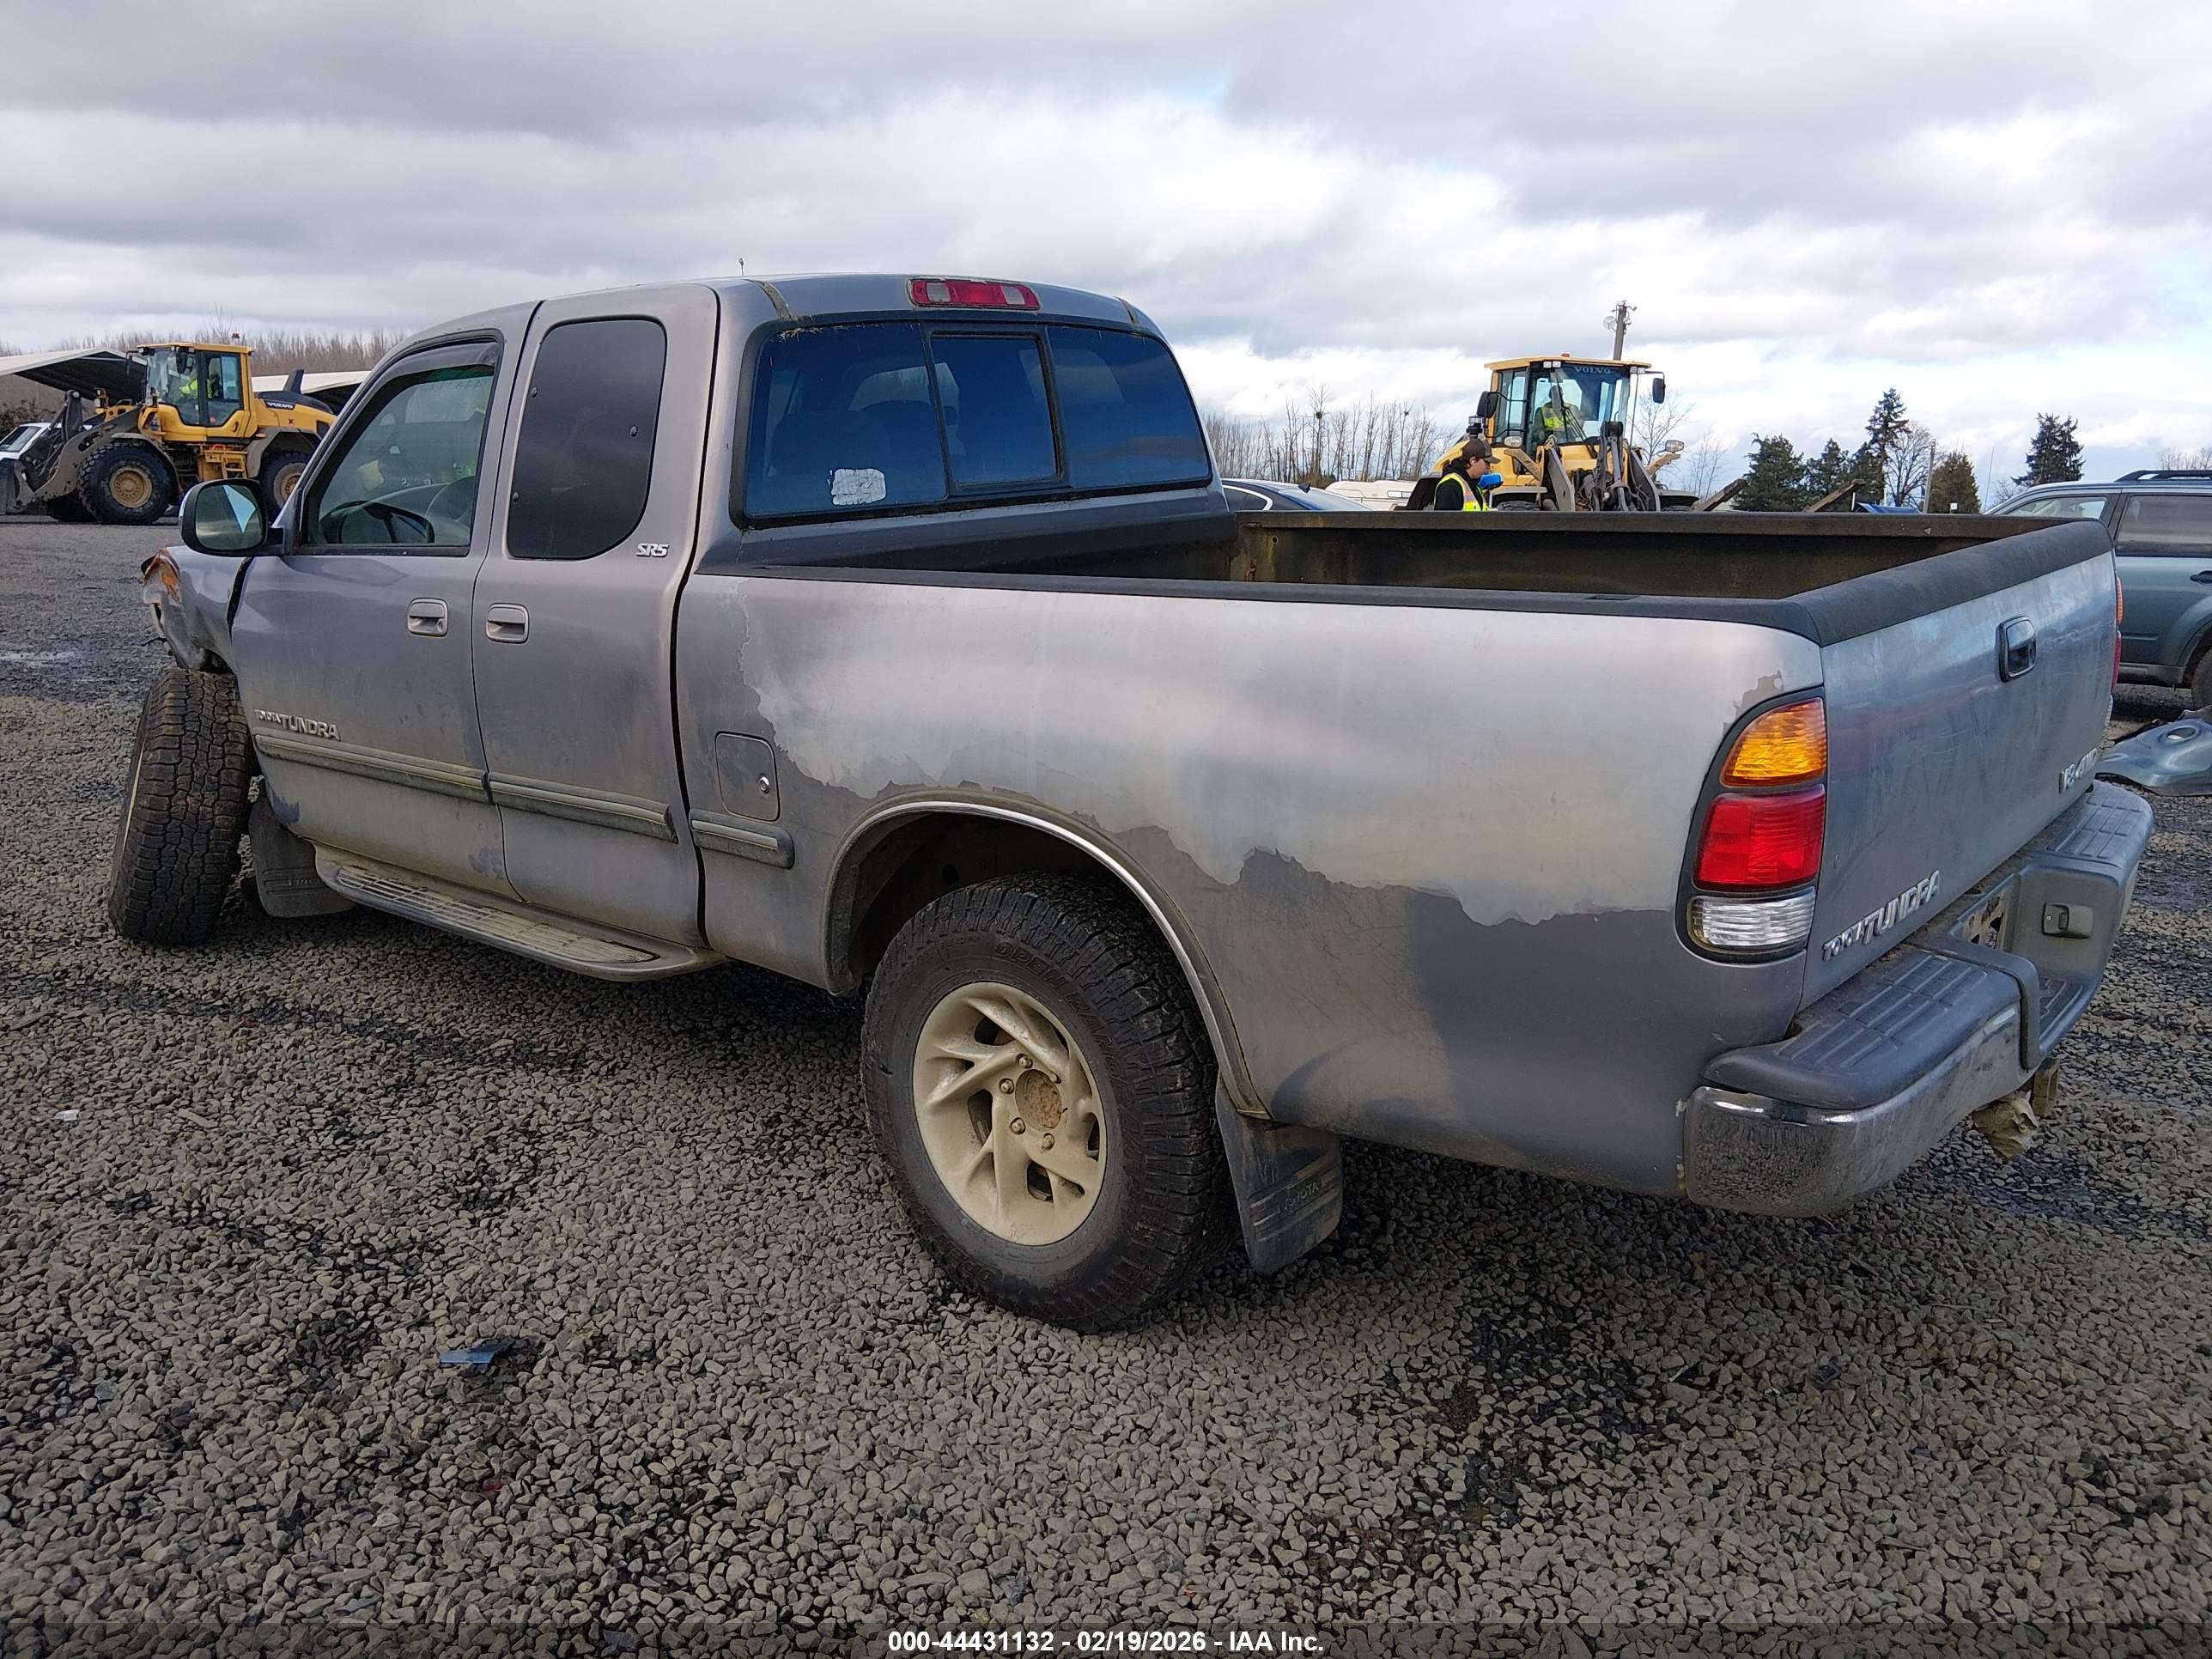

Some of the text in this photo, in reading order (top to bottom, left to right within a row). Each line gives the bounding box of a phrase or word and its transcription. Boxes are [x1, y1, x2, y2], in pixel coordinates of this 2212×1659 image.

[1572, 366, 1611, 374] VOLVO
[635, 543, 670, 558] SR5
[279, 714, 342, 741] TUNDRA
[1861, 869, 1941, 945] TUNDRA
